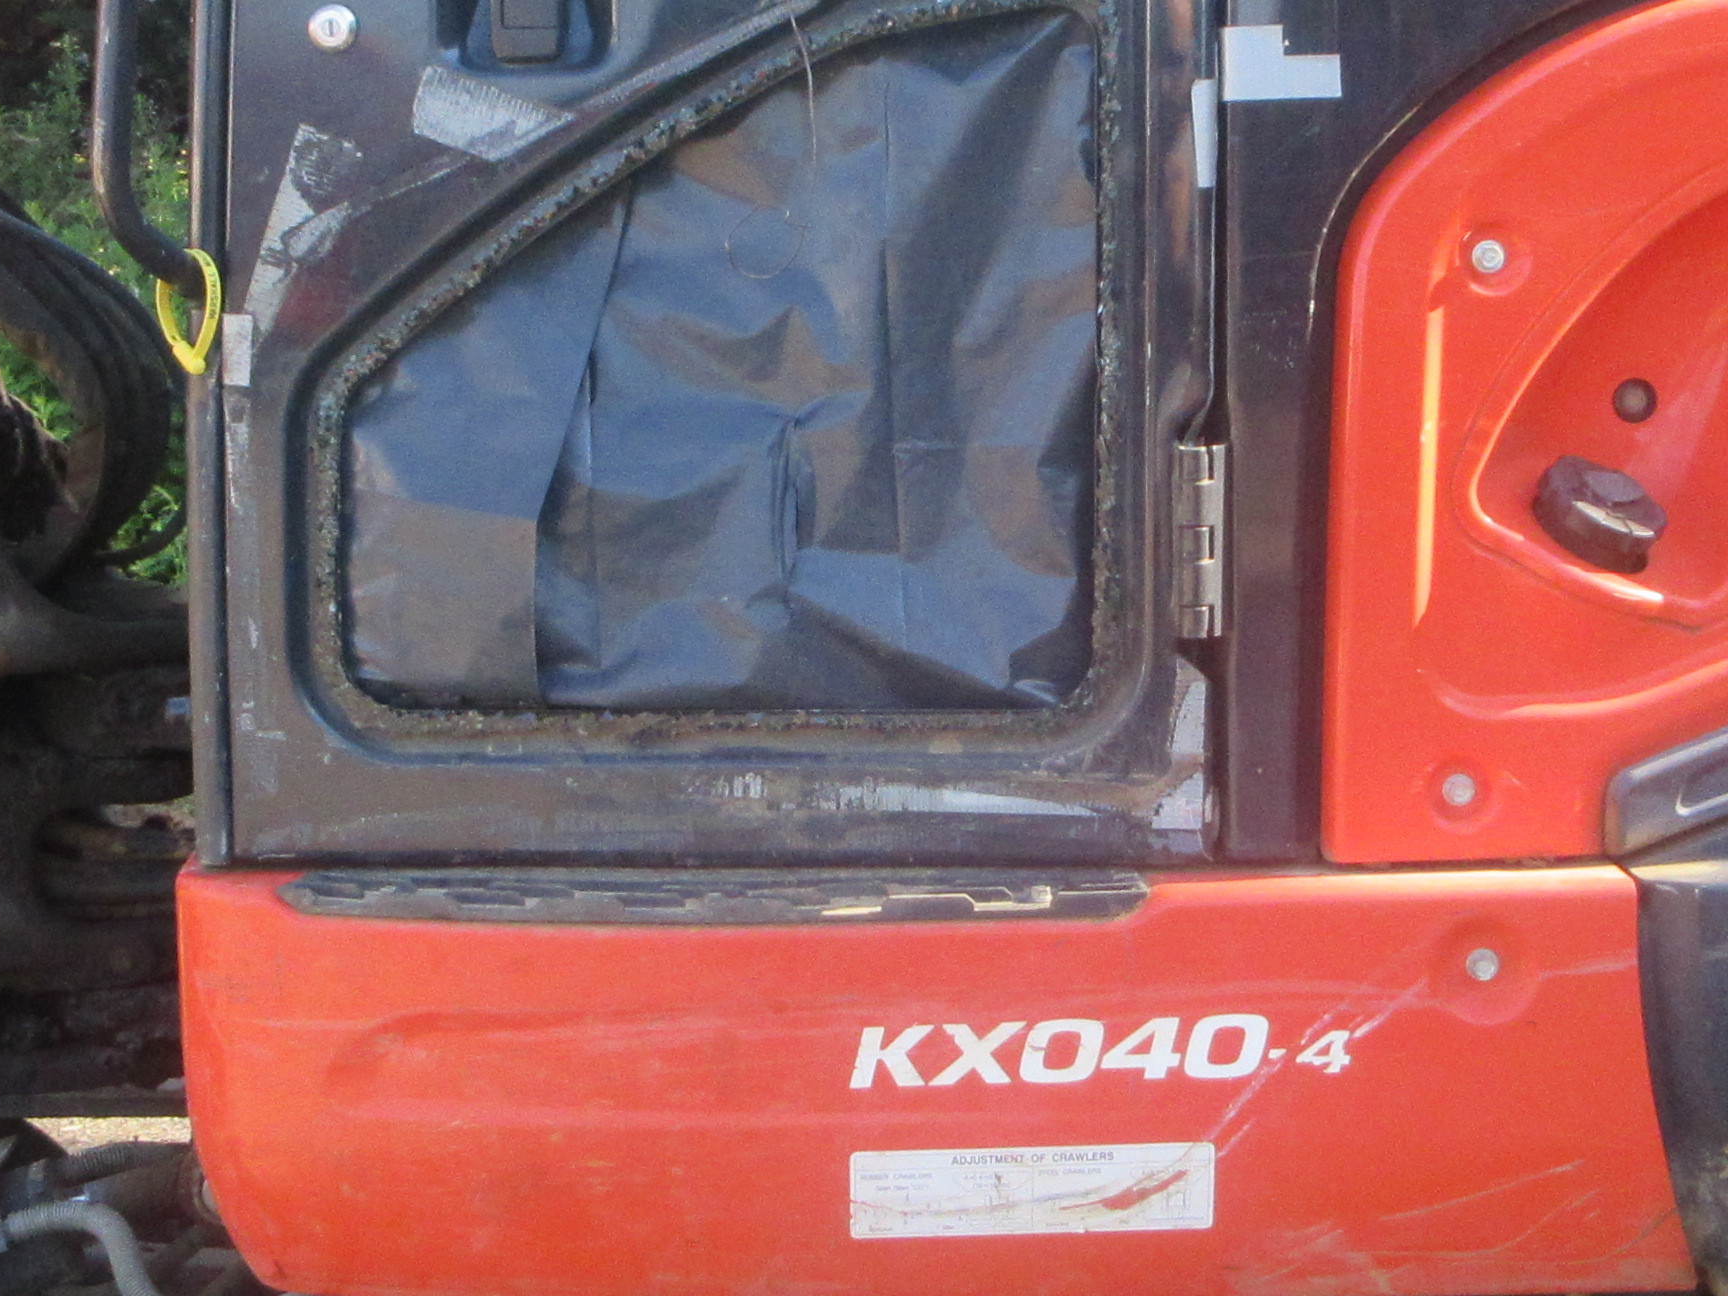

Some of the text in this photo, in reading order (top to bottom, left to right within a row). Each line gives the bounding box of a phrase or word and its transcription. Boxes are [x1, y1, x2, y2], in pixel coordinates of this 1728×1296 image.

[849, 1013, 1351, 1089] KX040-4
[951, 1151, 1115, 1166] ADJUSTMENT OF CRAWLERS
